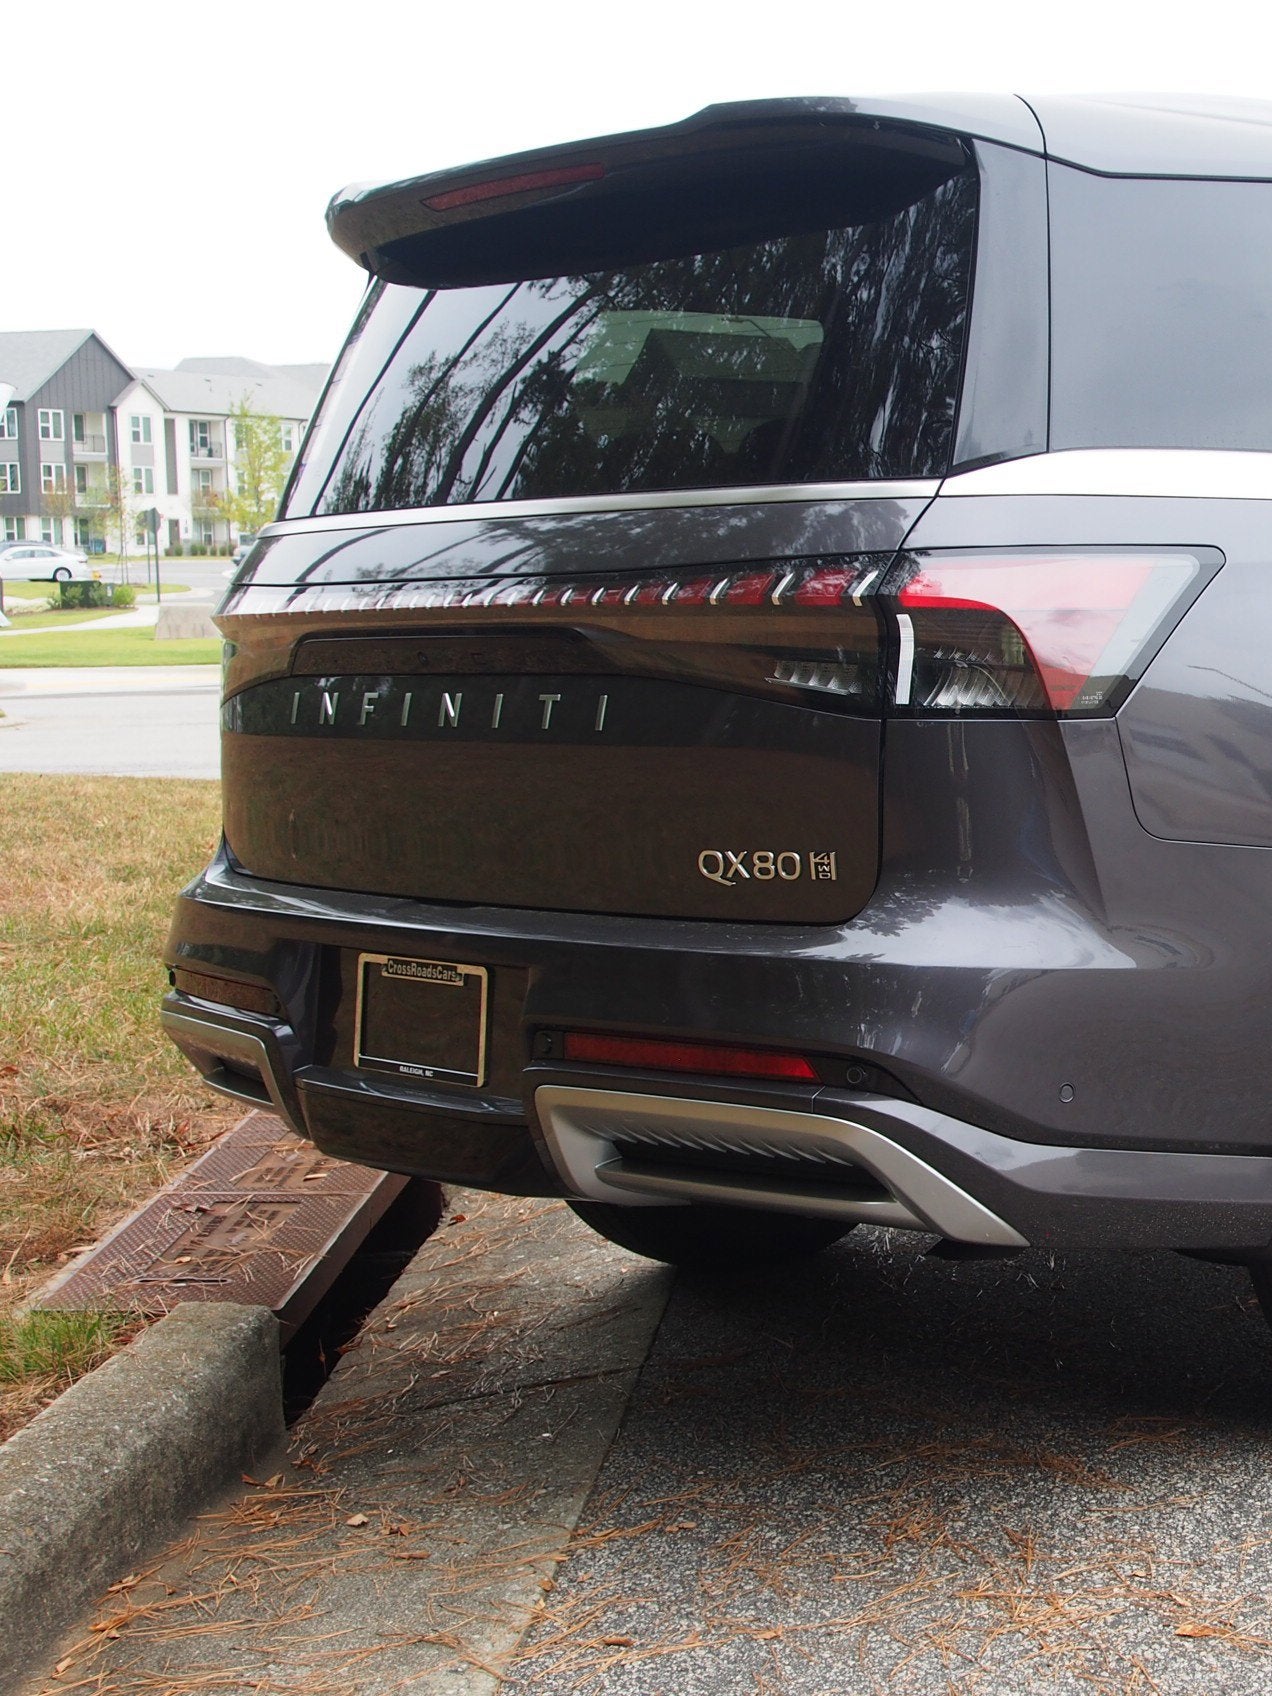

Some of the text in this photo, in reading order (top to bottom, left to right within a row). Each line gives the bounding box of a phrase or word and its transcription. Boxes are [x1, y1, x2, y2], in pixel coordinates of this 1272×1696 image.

[291, 692, 608, 731] INFINITI
[699, 850, 801, 886] QX80
[388, 960, 457, 982] CrossRoadsCars
